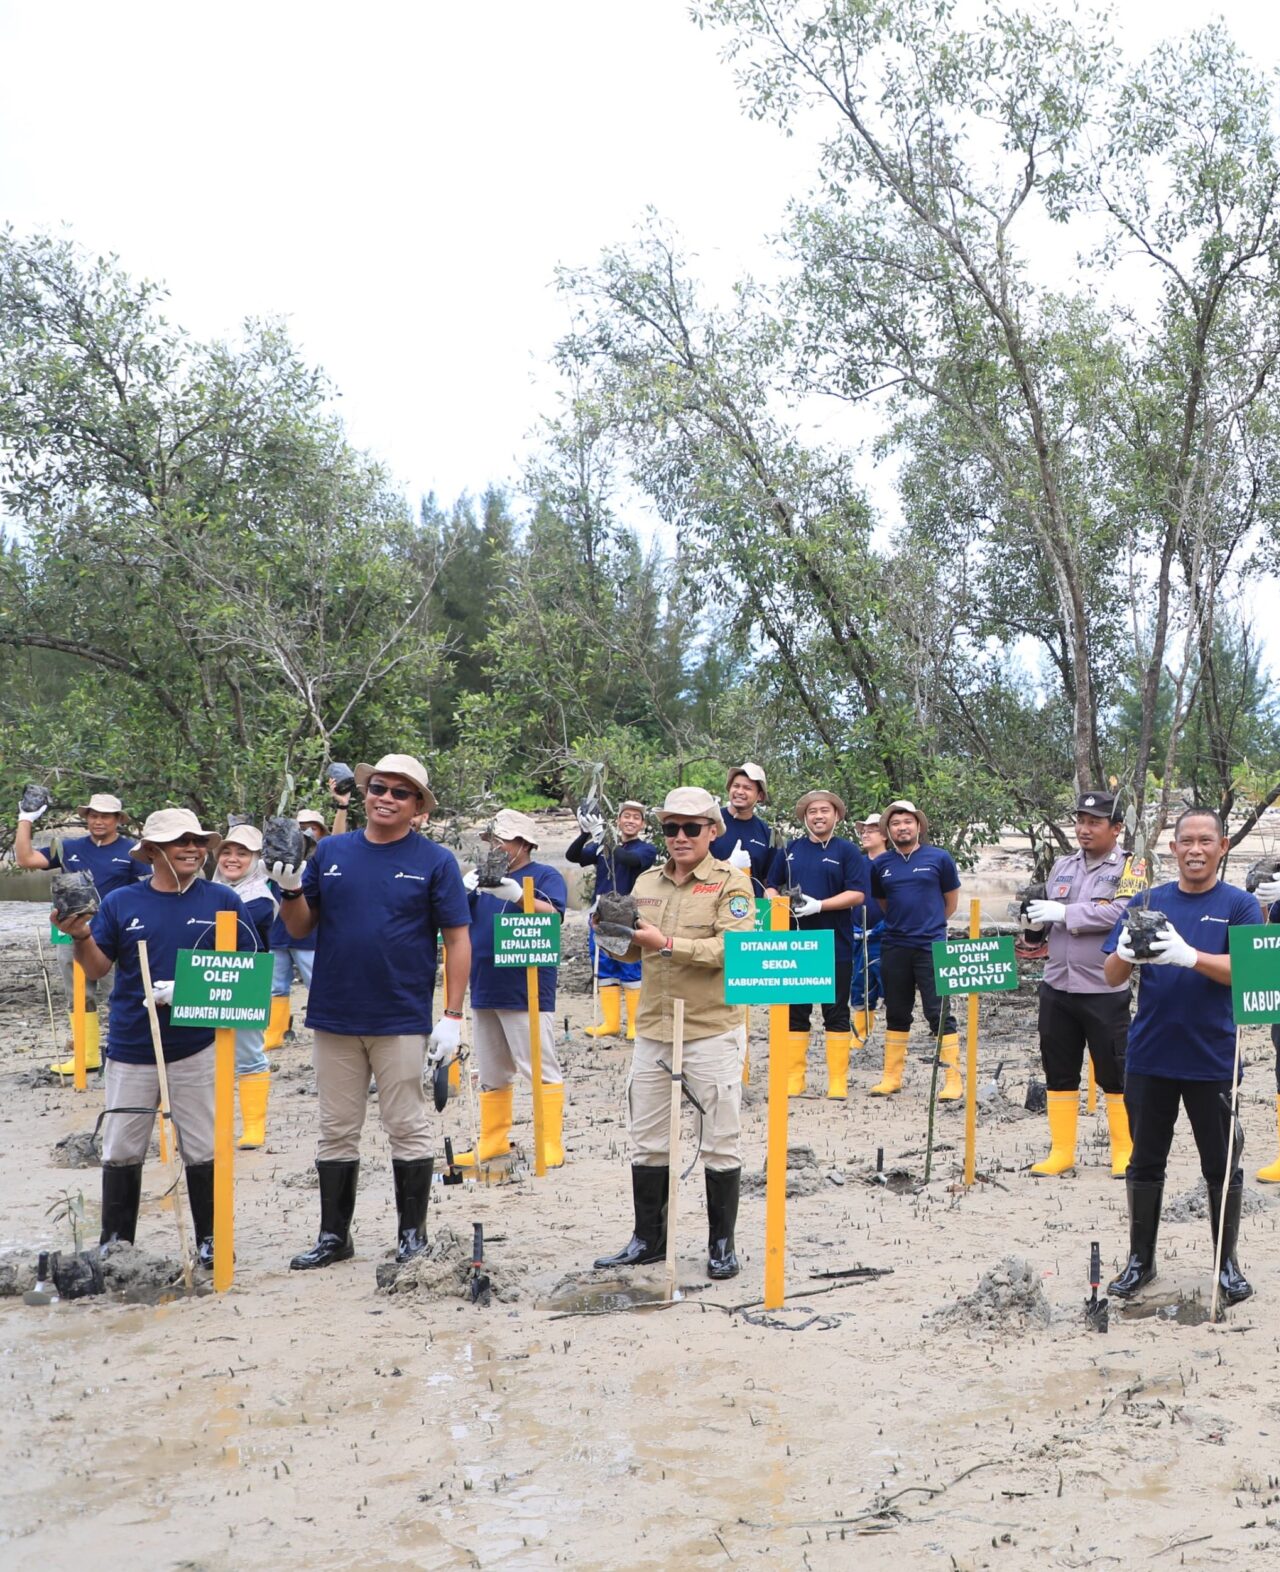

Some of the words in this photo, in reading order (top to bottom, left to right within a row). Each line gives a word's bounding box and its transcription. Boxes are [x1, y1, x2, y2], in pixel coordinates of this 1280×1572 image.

[501, 917, 551, 927] DITANAM
[512, 928, 542, 937] OLEH
[501, 939, 530, 950] KEPALA
[531, 939, 551, 949] DESA
[740, 941, 788, 952] DITANAM
[790, 940, 818, 951] OLEH
[946, 940, 999, 954] DITANAM
[191, 955, 254, 969] DITANAM
[494, 953, 527, 964] BUNYU
[529, 952, 559, 963] BARAT
[959, 952, 989, 964] OLEH
[761, 959, 798, 970] SEKDA
[939, 962, 1012, 978] KAPOLSEK
[203, 970, 240, 983] OLEH
[728, 977, 780, 987] KABUPATEN
[782, 976, 832, 986] BULUNGAN
[948, 973, 1005, 989] BUNYU
[209, 988, 232, 1001] DPRD
[173, 1005, 219, 1019] KABUPATEN
[220, 1007, 266, 1021] BULUNGAN
